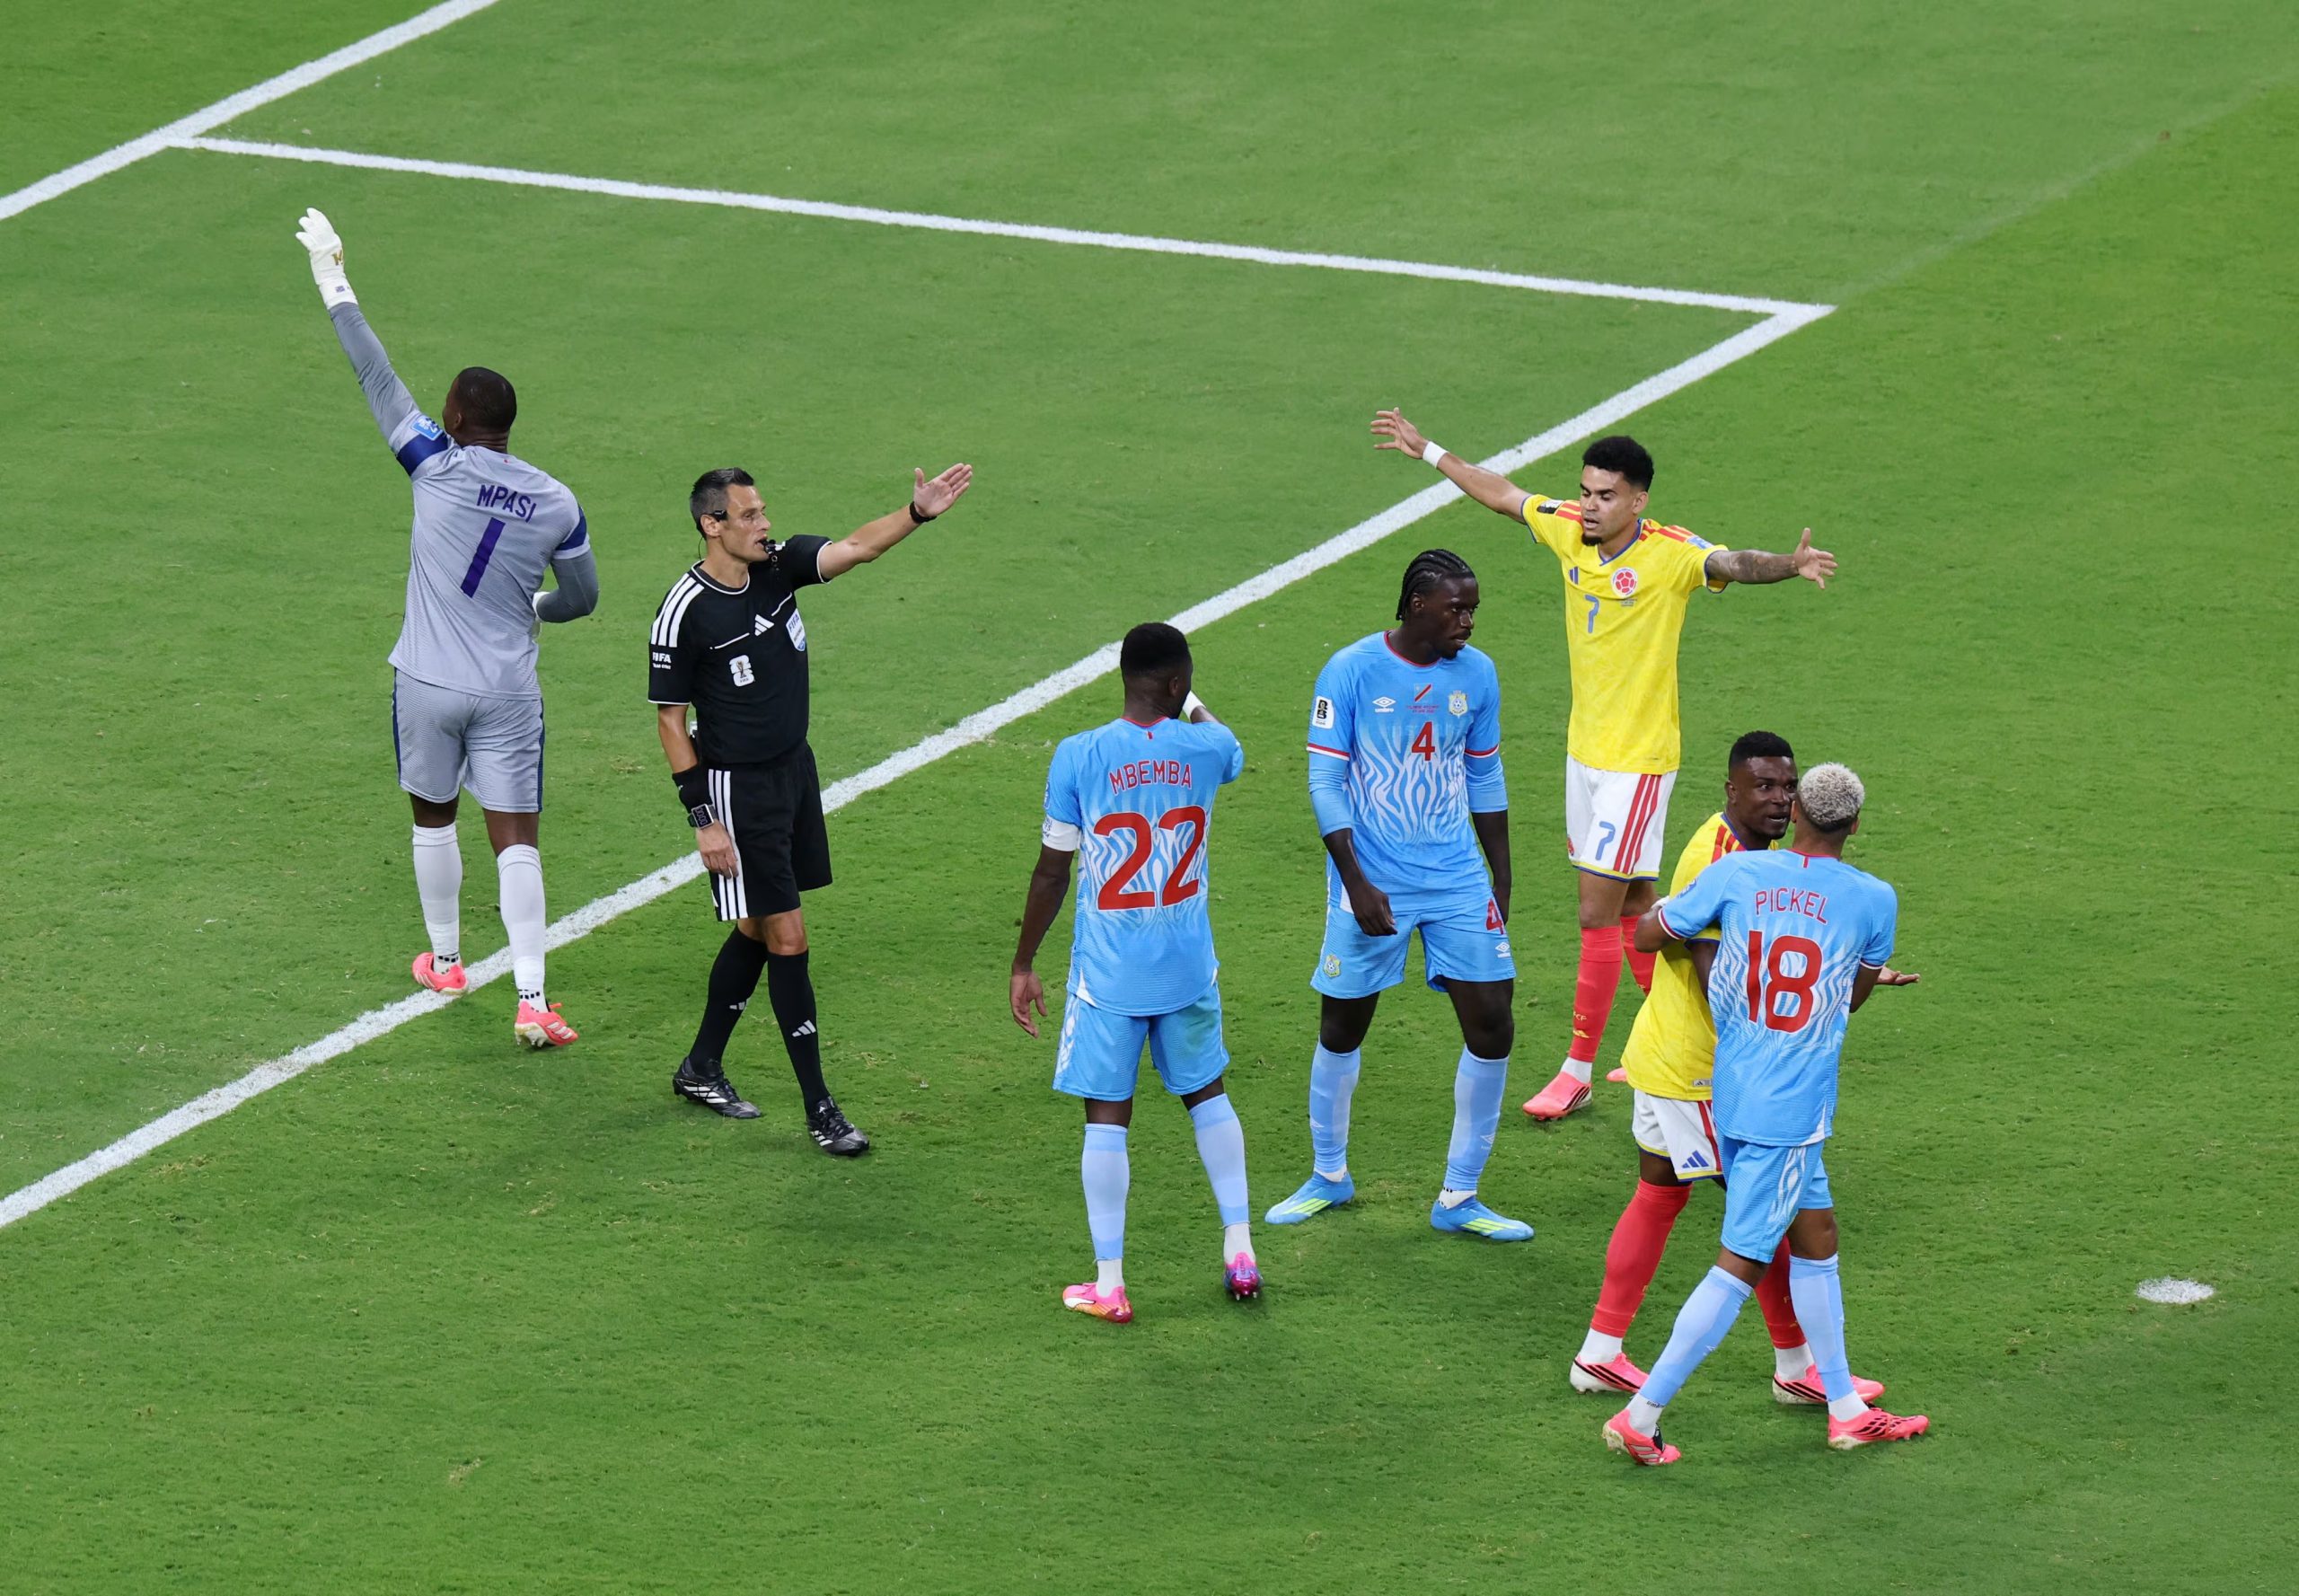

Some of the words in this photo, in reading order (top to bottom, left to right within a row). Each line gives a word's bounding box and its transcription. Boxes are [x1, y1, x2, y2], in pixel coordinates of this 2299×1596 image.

[477, 484, 536, 524] MPASI
[461, 516, 506, 598] 1
[788, 613, 800, 632] FIFA
[1584, 593, 1600, 634] 7
[652, 651, 672, 664] FIFA
[1411, 720, 1436, 763] 4
[1109, 759, 1193, 795] MBEMBA
[1093, 805, 1206, 911] 22
[1595, 820, 1616, 861] 7
[1485, 898, 1504, 935] 4
[1755, 887, 1829, 926] PICKEL
[1746, 929, 1824, 1034] 18
